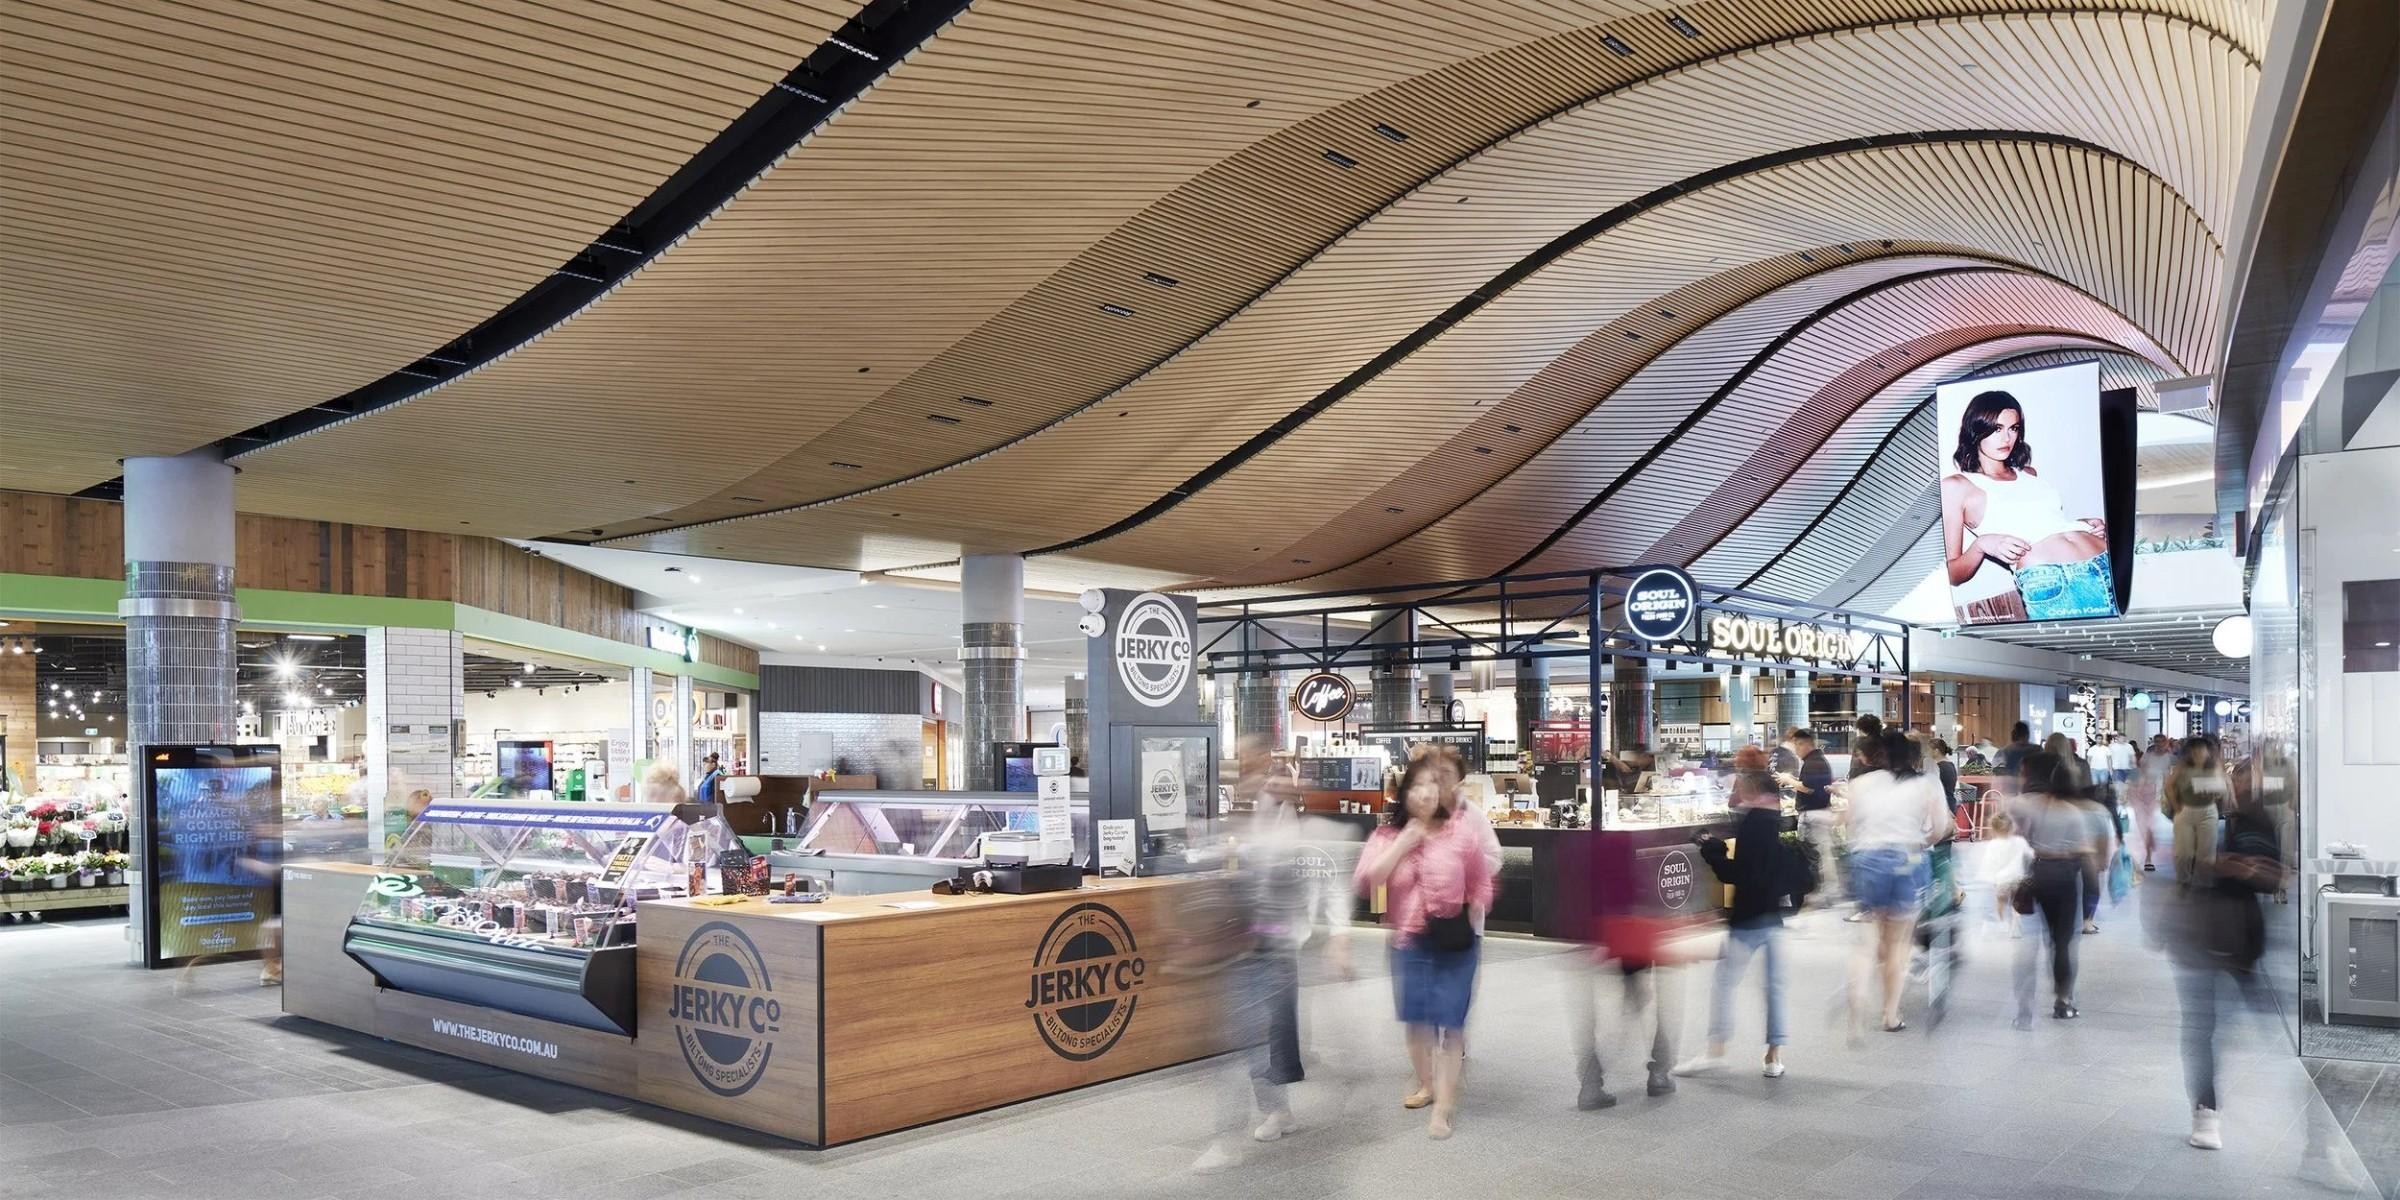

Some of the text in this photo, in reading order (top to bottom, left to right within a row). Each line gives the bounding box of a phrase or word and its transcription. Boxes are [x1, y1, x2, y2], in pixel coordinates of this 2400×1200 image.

[1637, 589, 1680, 601] SOUL
[1149, 607, 1160, 615] THE
[1630, 599, 1687, 611] ORIGIN
[2047, 608, 2082, 617] Calvin
[1712, 616, 1857, 663] SOUL ORIGIN
[1118, 637, 1169, 660] JERKY
[1149, 668, 1179, 692] SPECIALISTS
[287, 720, 337, 736] BUTCHER
[1150, 784, 1172, 793] JERKY
[179, 806, 251, 820] SUMMER IS
[186, 820, 245, 832] GOLDEN,
[175, 832, 217, 844] RIGHT
[1664, 862, 1687, 875] SOUL
[1660, 874, 1690, 888] ORIGIN
[1078, 914, 1095, 926] THE
[713, 935, 730, 947] THE
[1024, 963, 1112, 1008] JERKY
[668, 984, 746, 1029] JERKY
[1046, 1003, 1128, 1049] BILTONG SPECIALISTS
[432, 1017, 559, 1059] WWW.THEJERKYCO.COM.AU
[685, 1032, 762, 1084] BILTONG SPECIALISTS
